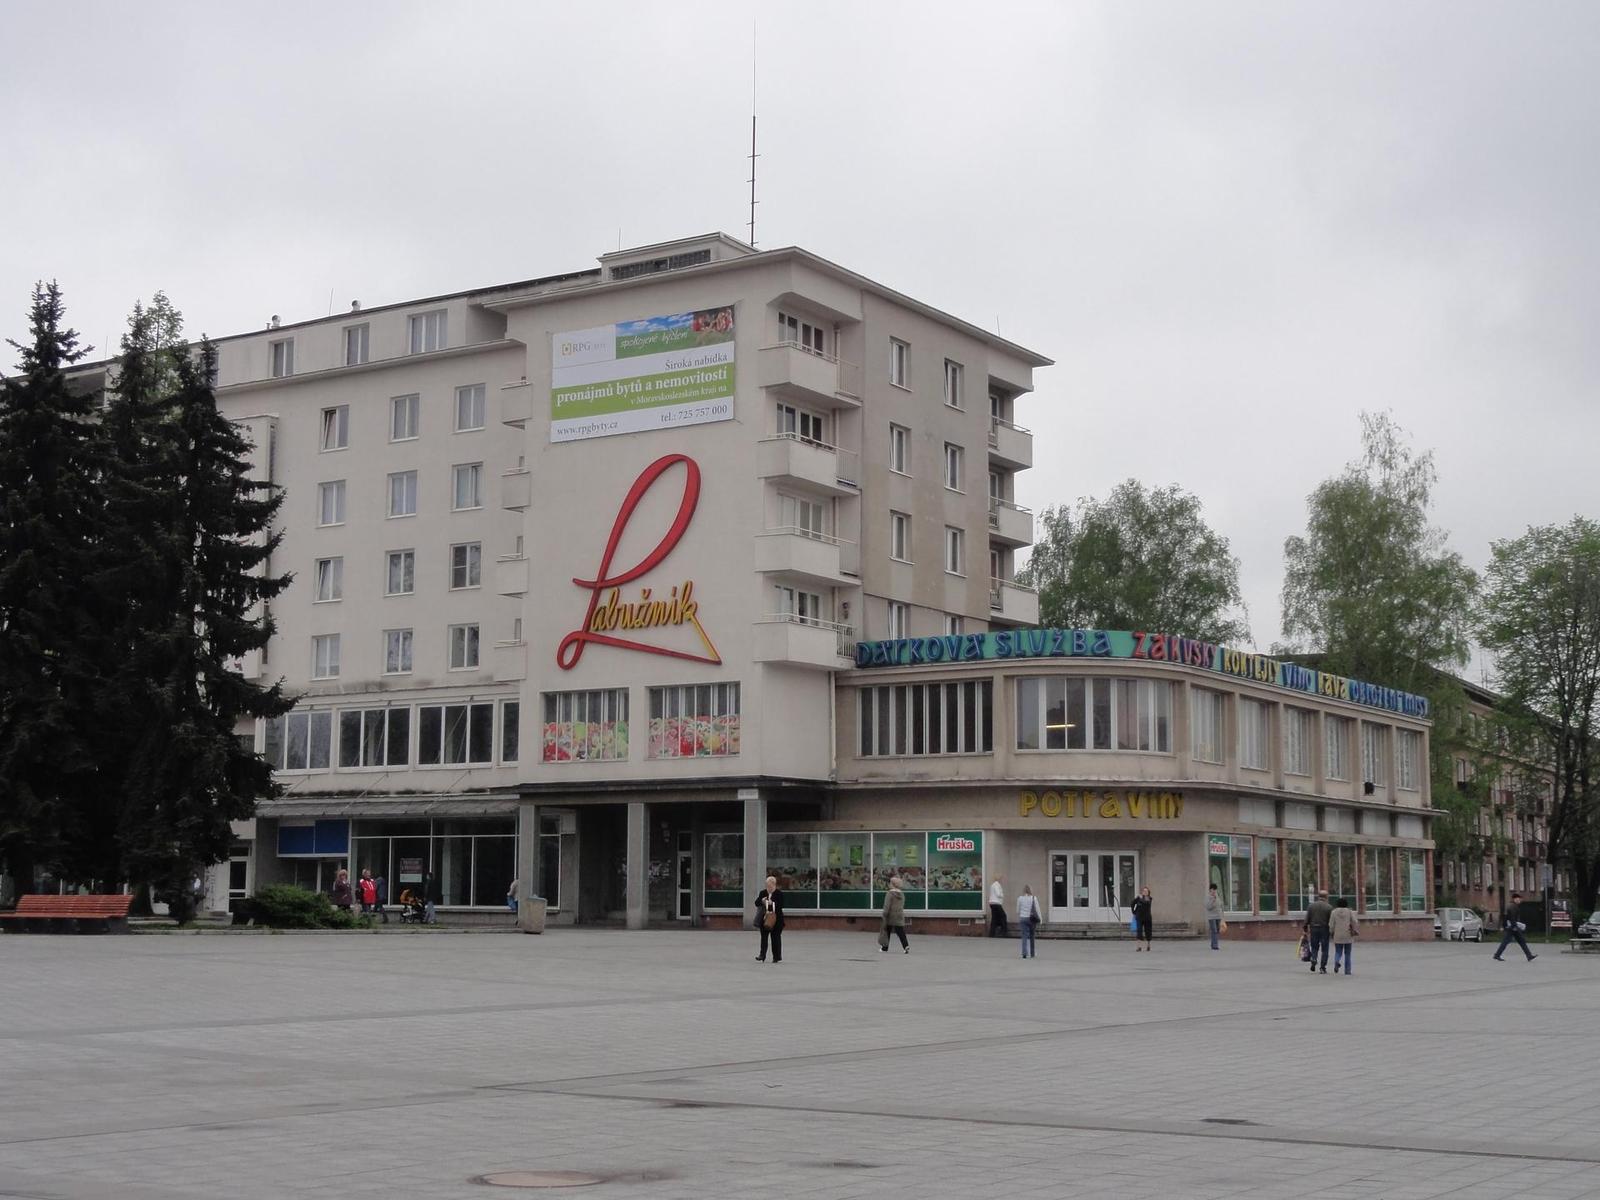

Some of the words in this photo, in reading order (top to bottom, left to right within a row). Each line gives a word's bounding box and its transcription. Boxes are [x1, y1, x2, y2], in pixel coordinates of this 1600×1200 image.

[573, 342, 591, 352] RPG
[665, 357, 692, 371] Široká
[694, 352, 728, 367] nabídka
[556, 384, 614, 407] pronájmů
[616, 379, 643, 397] bytů
[645, 381, 653, 391] a
[655, 366, 728, 390] nemovitostí
[718, 384, 728, 393] na
[661, 412, 677, 423] tel.:
[678, 409, 694, 420] 725
[695, 406, 712, 418] 757
[712, 404, 728, 415] 000
[557, 421, 618, 437] www.rpgbyty.cz
[938, 837, 973, 850] Hruška
